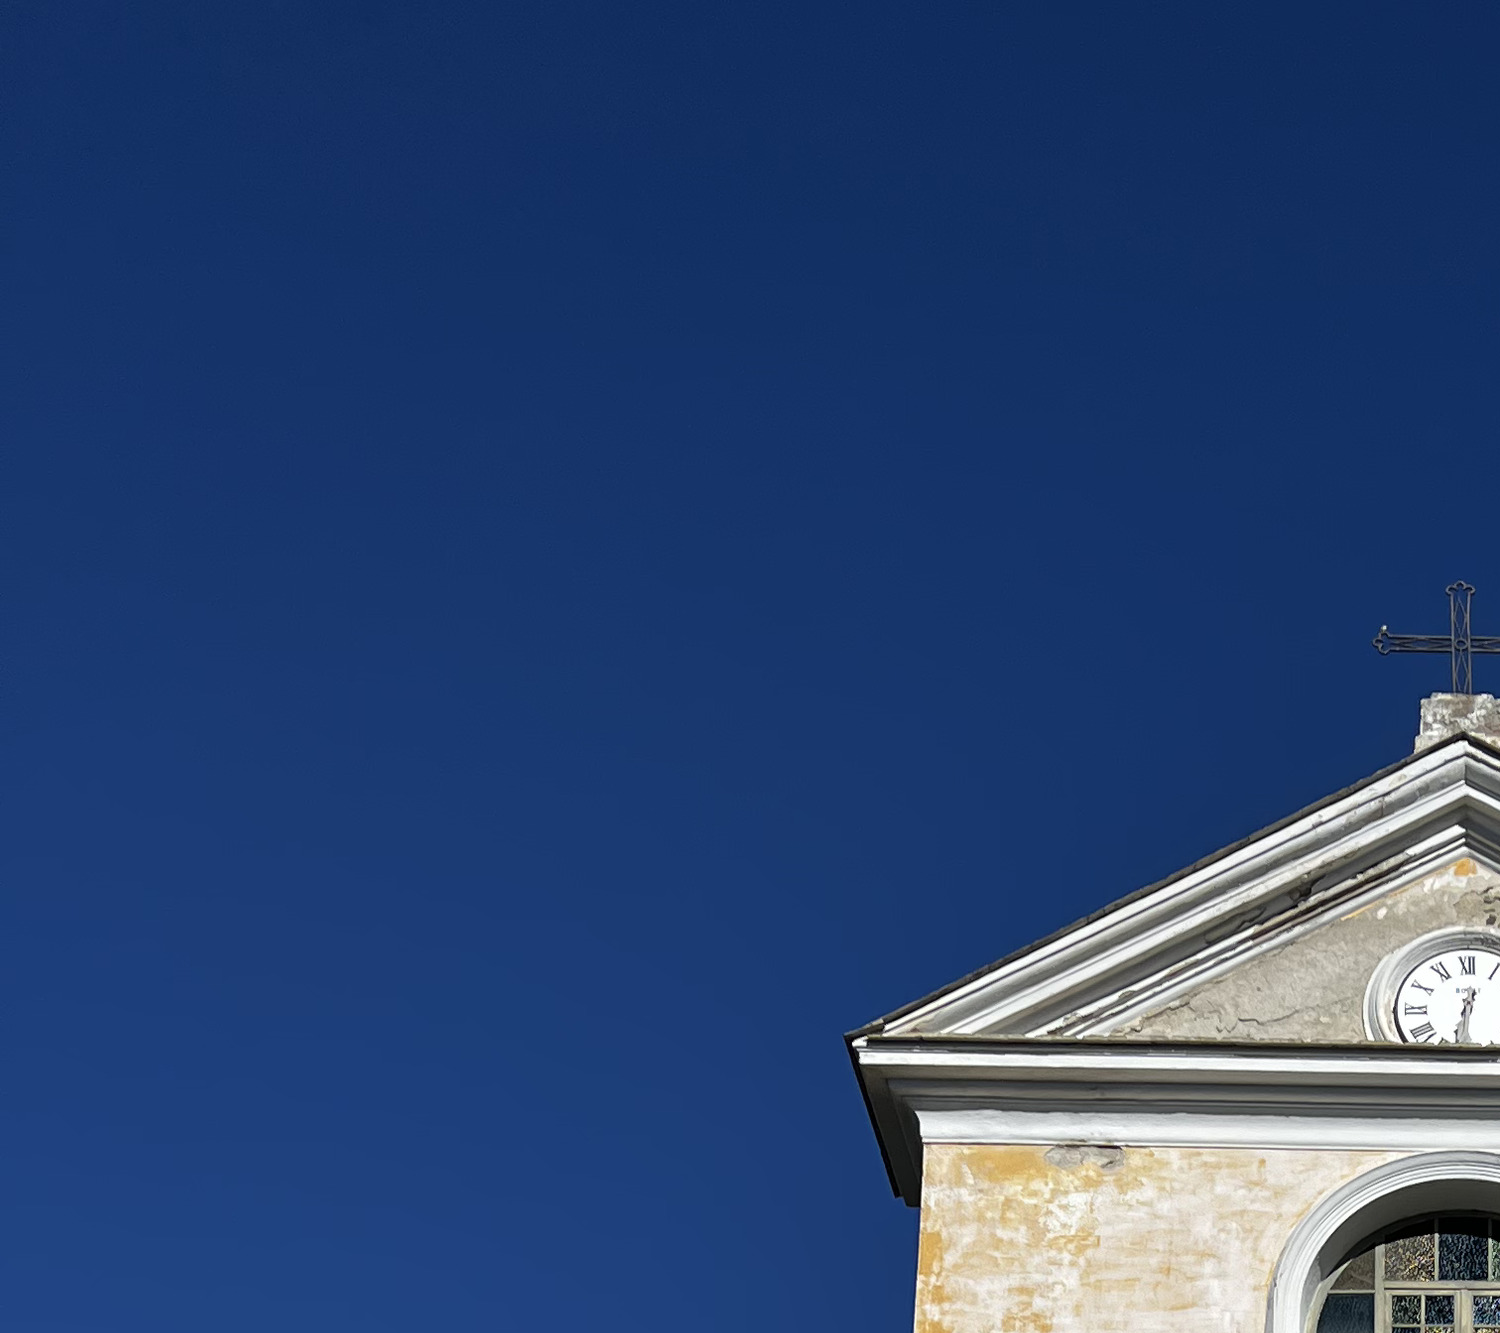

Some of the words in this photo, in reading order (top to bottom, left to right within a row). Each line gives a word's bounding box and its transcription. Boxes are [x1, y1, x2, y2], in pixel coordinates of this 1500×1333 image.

[1430, 961, 1452, 983] XI
[1457, 956, 1476, 976] XII
[1411, 979, 1435, 996] X
